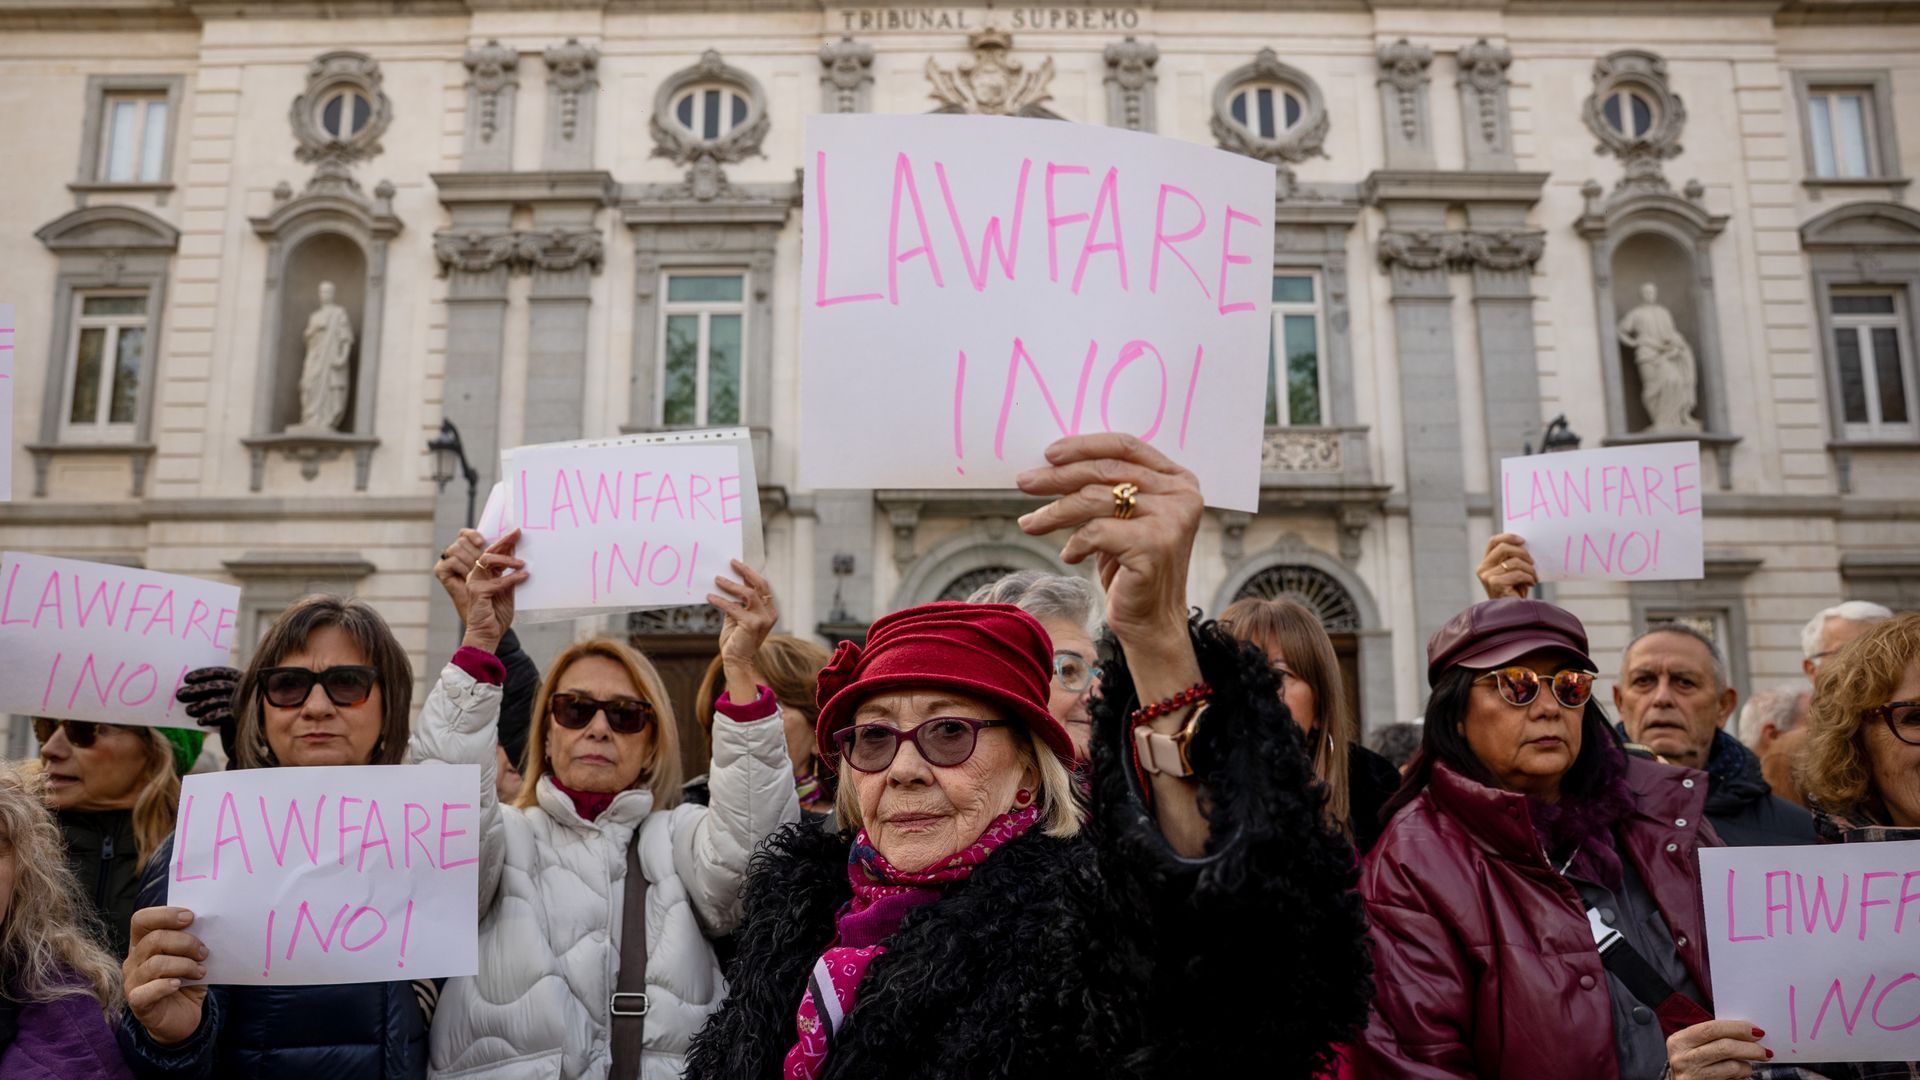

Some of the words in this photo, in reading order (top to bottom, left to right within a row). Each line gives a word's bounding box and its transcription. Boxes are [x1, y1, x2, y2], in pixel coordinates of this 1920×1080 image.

[841, 9, 972, 29] TRIBUNAL
[1011, 9, 1139, 29] SUPREMO
[815, 150, 1262, 316] LAWFARE
[520, 467, 742, 531] LAWFARE
[1504, 462, 1700, 521] LAWFARE
[0, 563, 237, 651] LAWFARE
[175, 791, 480, 883] LAWFARE
